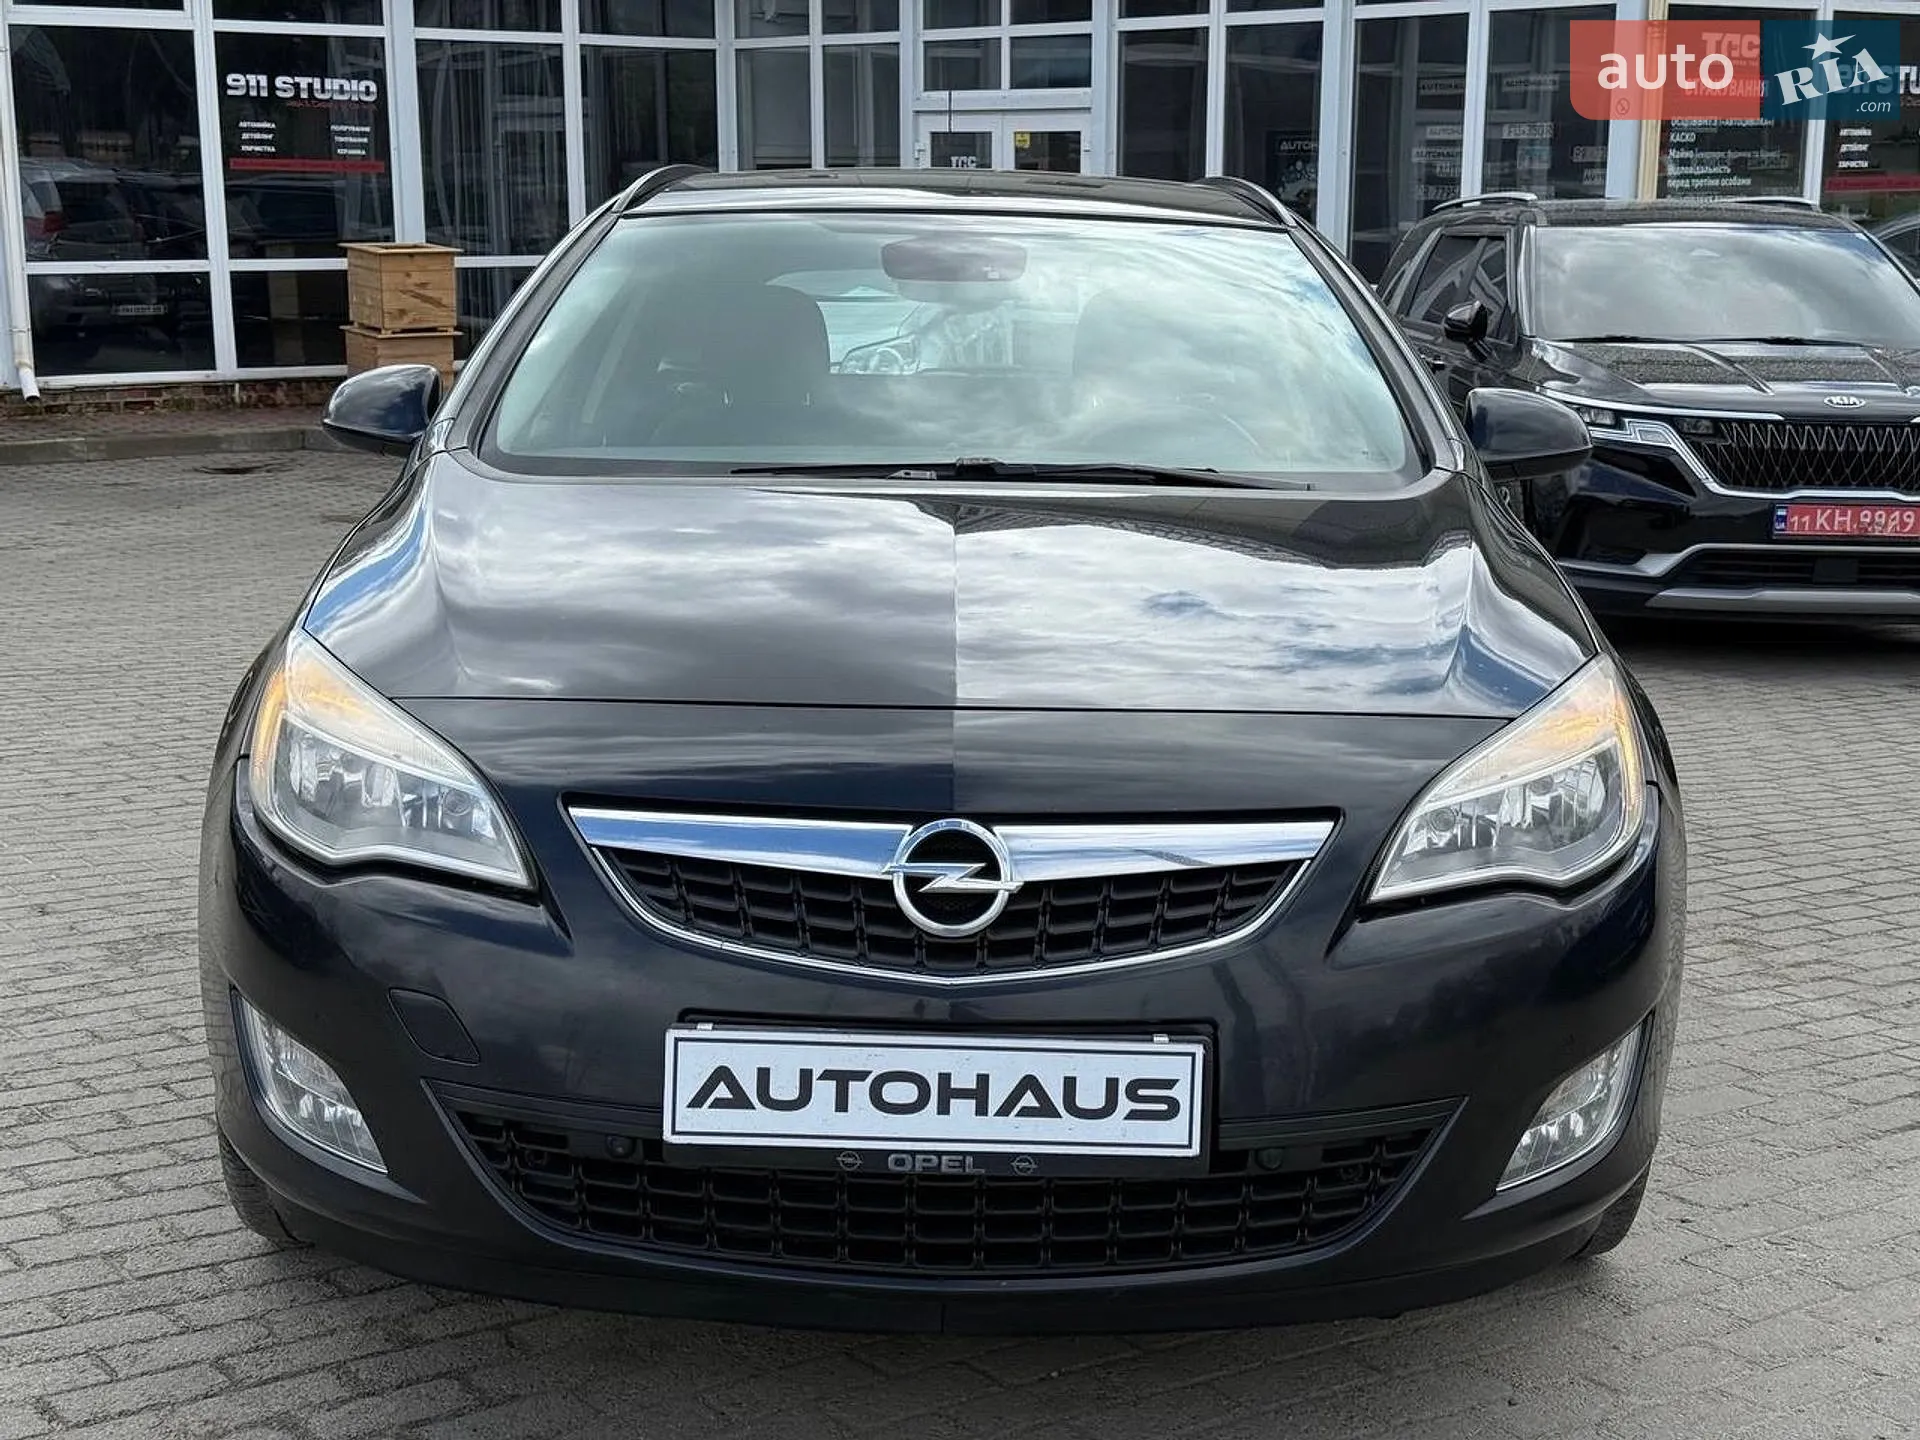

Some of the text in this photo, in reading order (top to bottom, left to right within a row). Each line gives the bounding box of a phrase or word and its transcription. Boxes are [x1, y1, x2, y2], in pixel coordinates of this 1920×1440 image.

[226, 73, 378, 102] 911 STUDIO
[686, 1065, 1181, 1121] AUTOHAUS
[888, 1154, 985, 1174] OPEL
